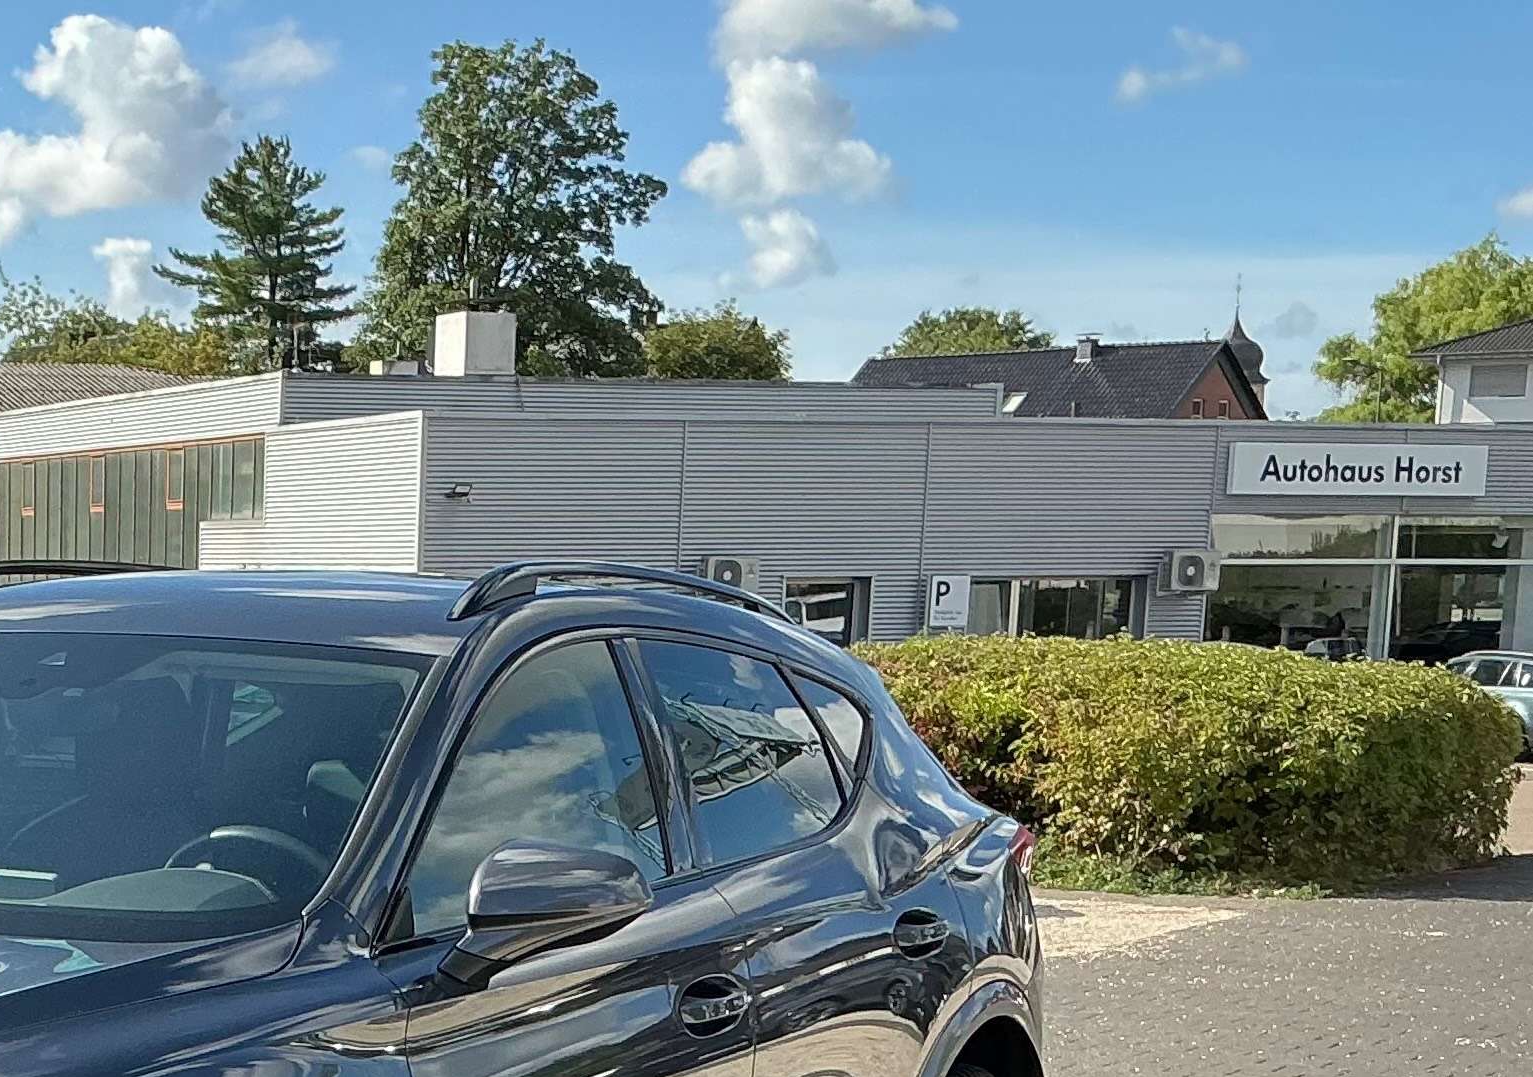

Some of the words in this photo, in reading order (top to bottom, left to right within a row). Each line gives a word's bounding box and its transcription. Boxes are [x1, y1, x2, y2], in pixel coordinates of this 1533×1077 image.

[1259, 453, 1385, 483] Autohaus
[1394, 455, 1463, 484] Horst
[935, 580, 951, 607] P
